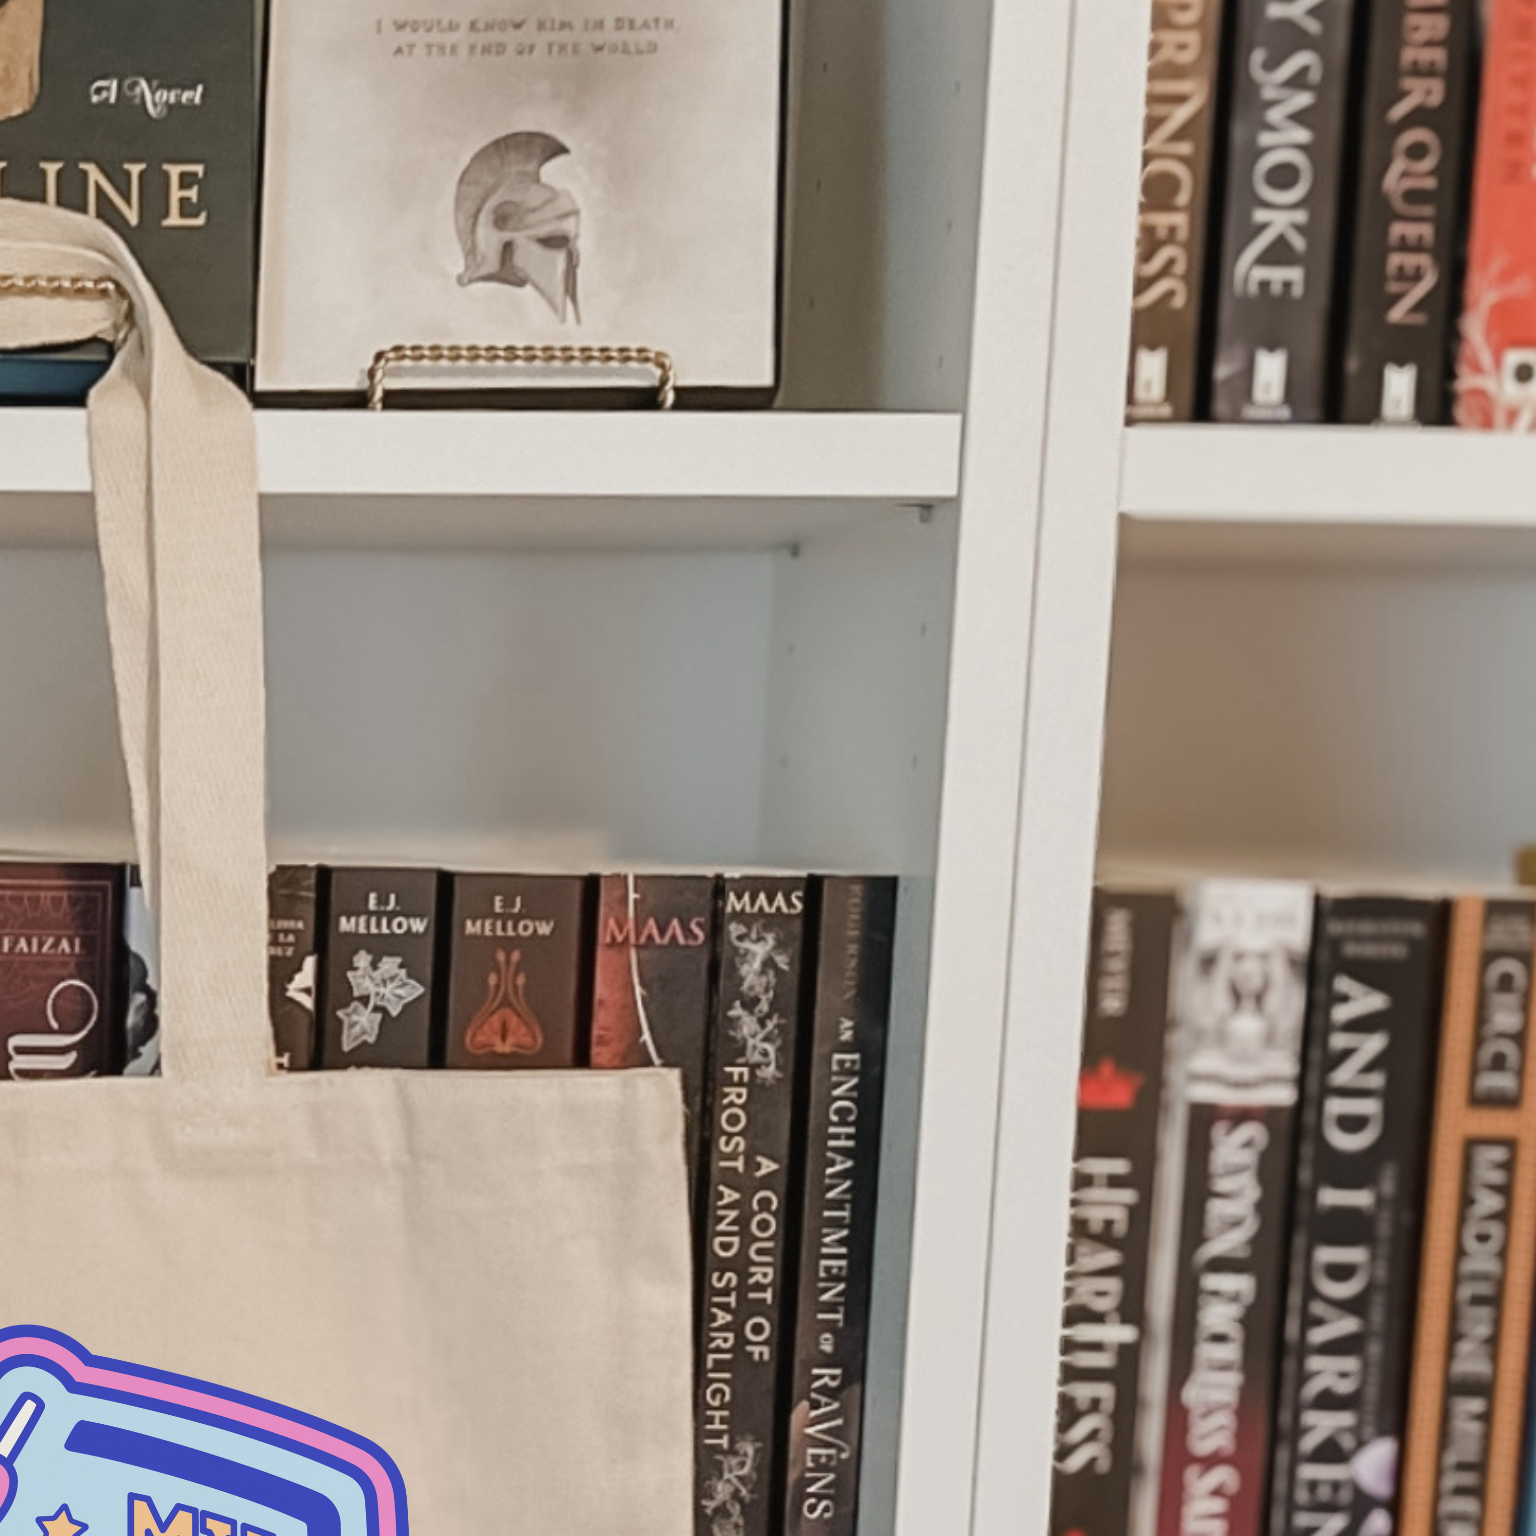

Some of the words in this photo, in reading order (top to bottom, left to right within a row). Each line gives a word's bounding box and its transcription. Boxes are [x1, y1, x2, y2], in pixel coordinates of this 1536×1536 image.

[393, 18, 460, 33] WOULD
[469, 18, 525, 33] KNOW
[537, 18, 574, 33] HIM
[584, 18, 606, 33] IN
[393, 43, 415, 57] AT
[425, 43, 459, 57] THE
[469, 43, 506, 57] END
[516, 43, 536, 57] OF
[547, 42, 581, 56] THE
[591, 41, 659, 56] WORLD
[1386, 0, 1450, 123] BER
[90, 78, 117, 105] A
[126, 77, 203, 118] Novel
[1234, 47, 1323, 298] SMOKE
[1382, 127, 1442, 324] QUEEN
[339, 914, 428, 935] MELLOW
[726, 891, 804, 914] MAAS
[2, 936, 86, 955] FAIZAL
[465, 918, 553, 937] MELLOW
[605, 916, 705, 944] MAAS
[838, 1017, 856, 1042] AN
[1472, 957, 1523, 1100] CIRCE
[1321, 974, 1393, 1154] AND
[718, 1066, 749, 1174] FROST
[755, 1155, 779, 1177] A
[814, 1051, 861, 1328] ENCHANTMENT
[1316, 1184, 1374, 1213] I
[714, 1187, 741, 1259] AND
[748, 1189, 778, 1303] COURT
[1447, 1142, 1512, 1386] MADELINE
[703, 1271, 739, 1450] STARLIGHT
[746, 1318, 770, 1362] OF
[817, 1332, 835, 1353] OF
[803, 1367, 853, 1520] RAVENS
